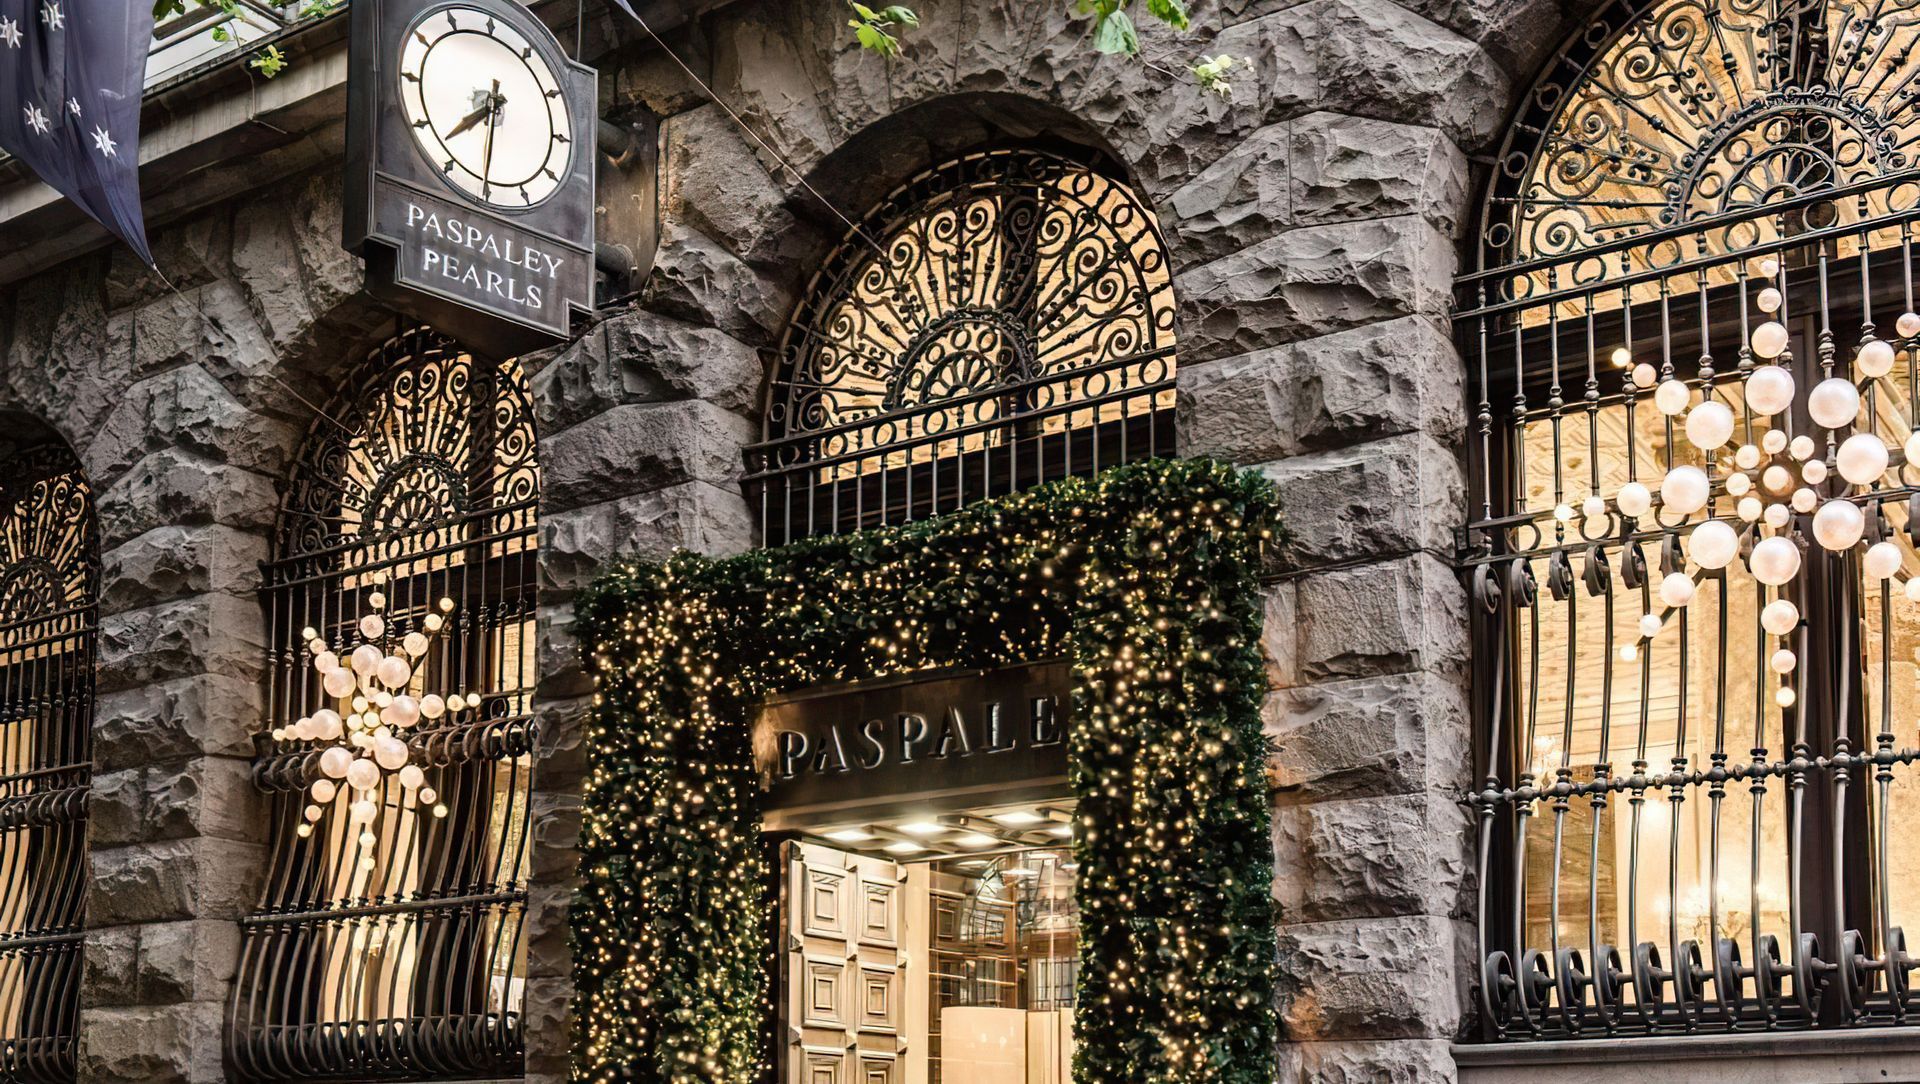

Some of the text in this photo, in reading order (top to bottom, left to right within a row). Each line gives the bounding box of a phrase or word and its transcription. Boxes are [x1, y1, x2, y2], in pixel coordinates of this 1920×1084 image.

[406, 204, 563, 278] PASPALEY
[423, 248, 542, 308] PEARLS
[775, 696, 1061, 779] PASPALE
